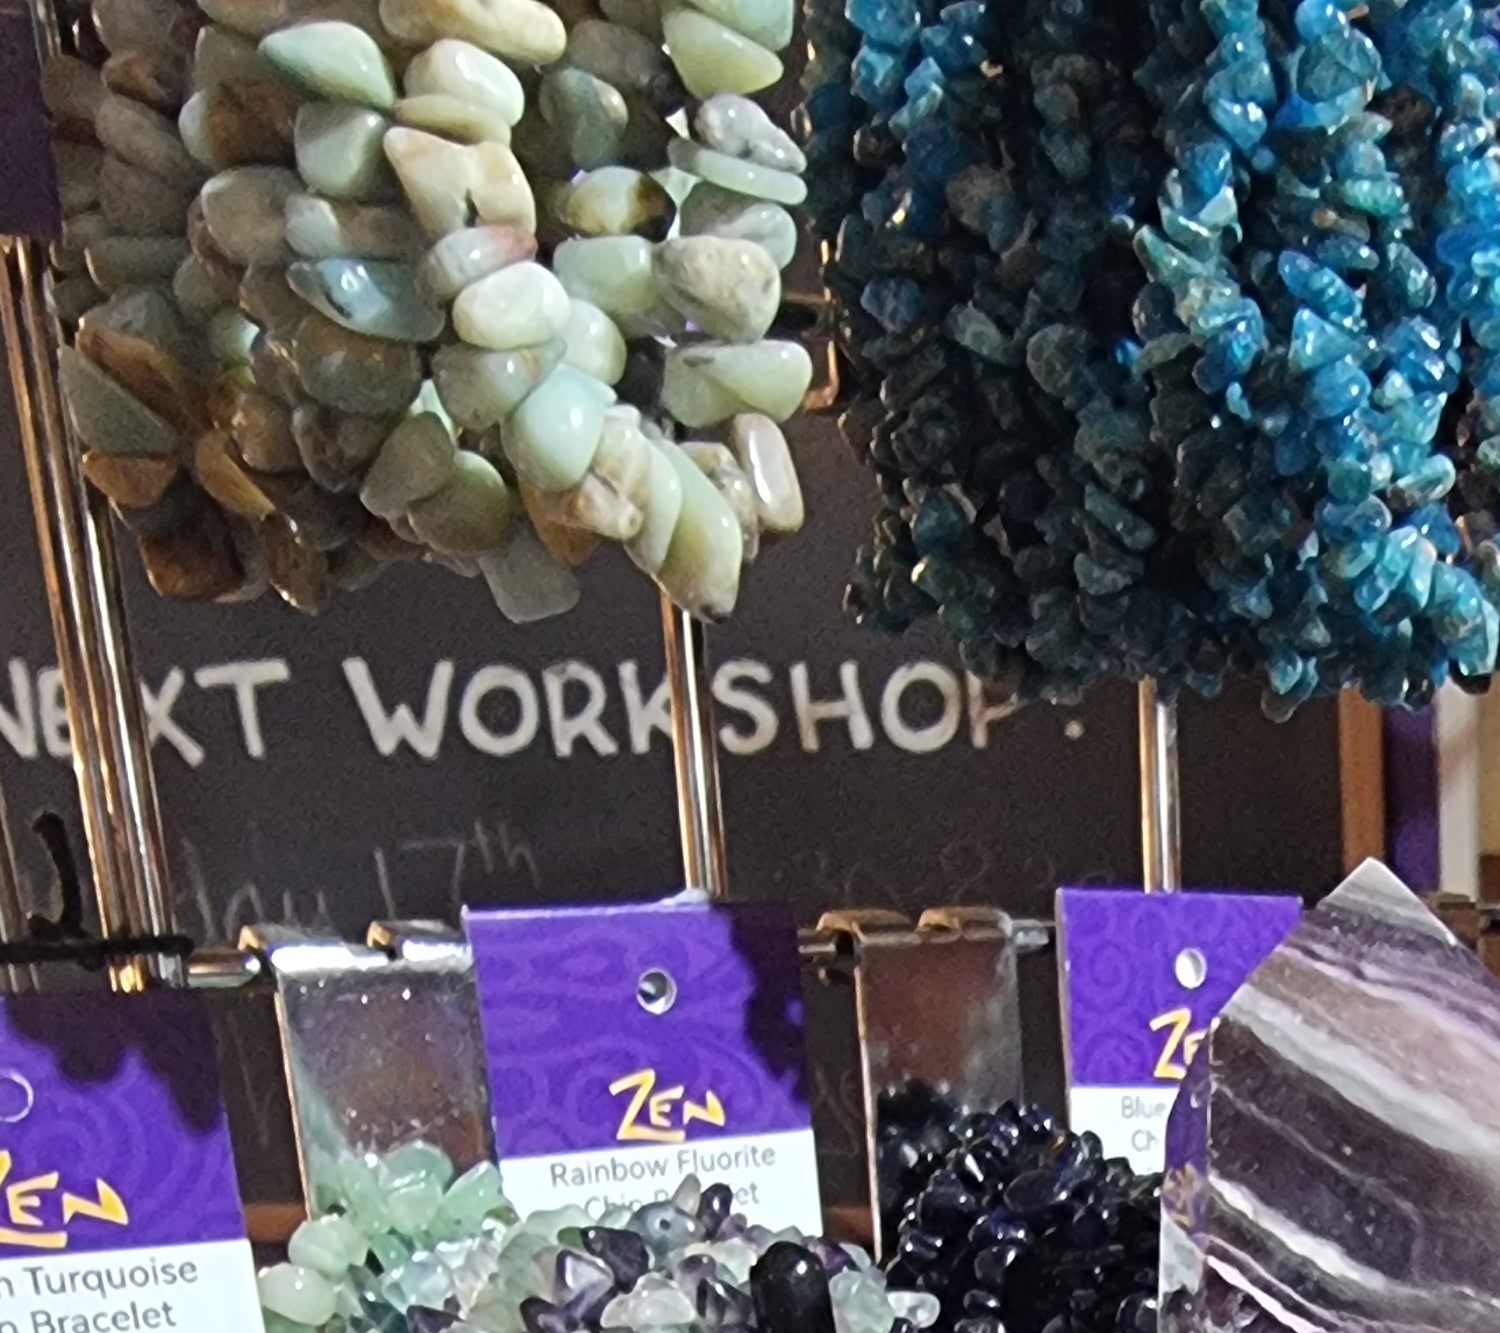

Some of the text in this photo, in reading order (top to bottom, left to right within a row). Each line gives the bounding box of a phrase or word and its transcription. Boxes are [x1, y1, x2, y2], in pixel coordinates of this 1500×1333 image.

[608, 1068, 725, 1142] ZEN
[1121, 1095, 1167, 1119] Blue
[1131, 1128, 1161, 1152] Ch
[550, 1145, 776, 1188] Rainbow Fluorite
[23, 1257, 198, 1299] Turquoise
